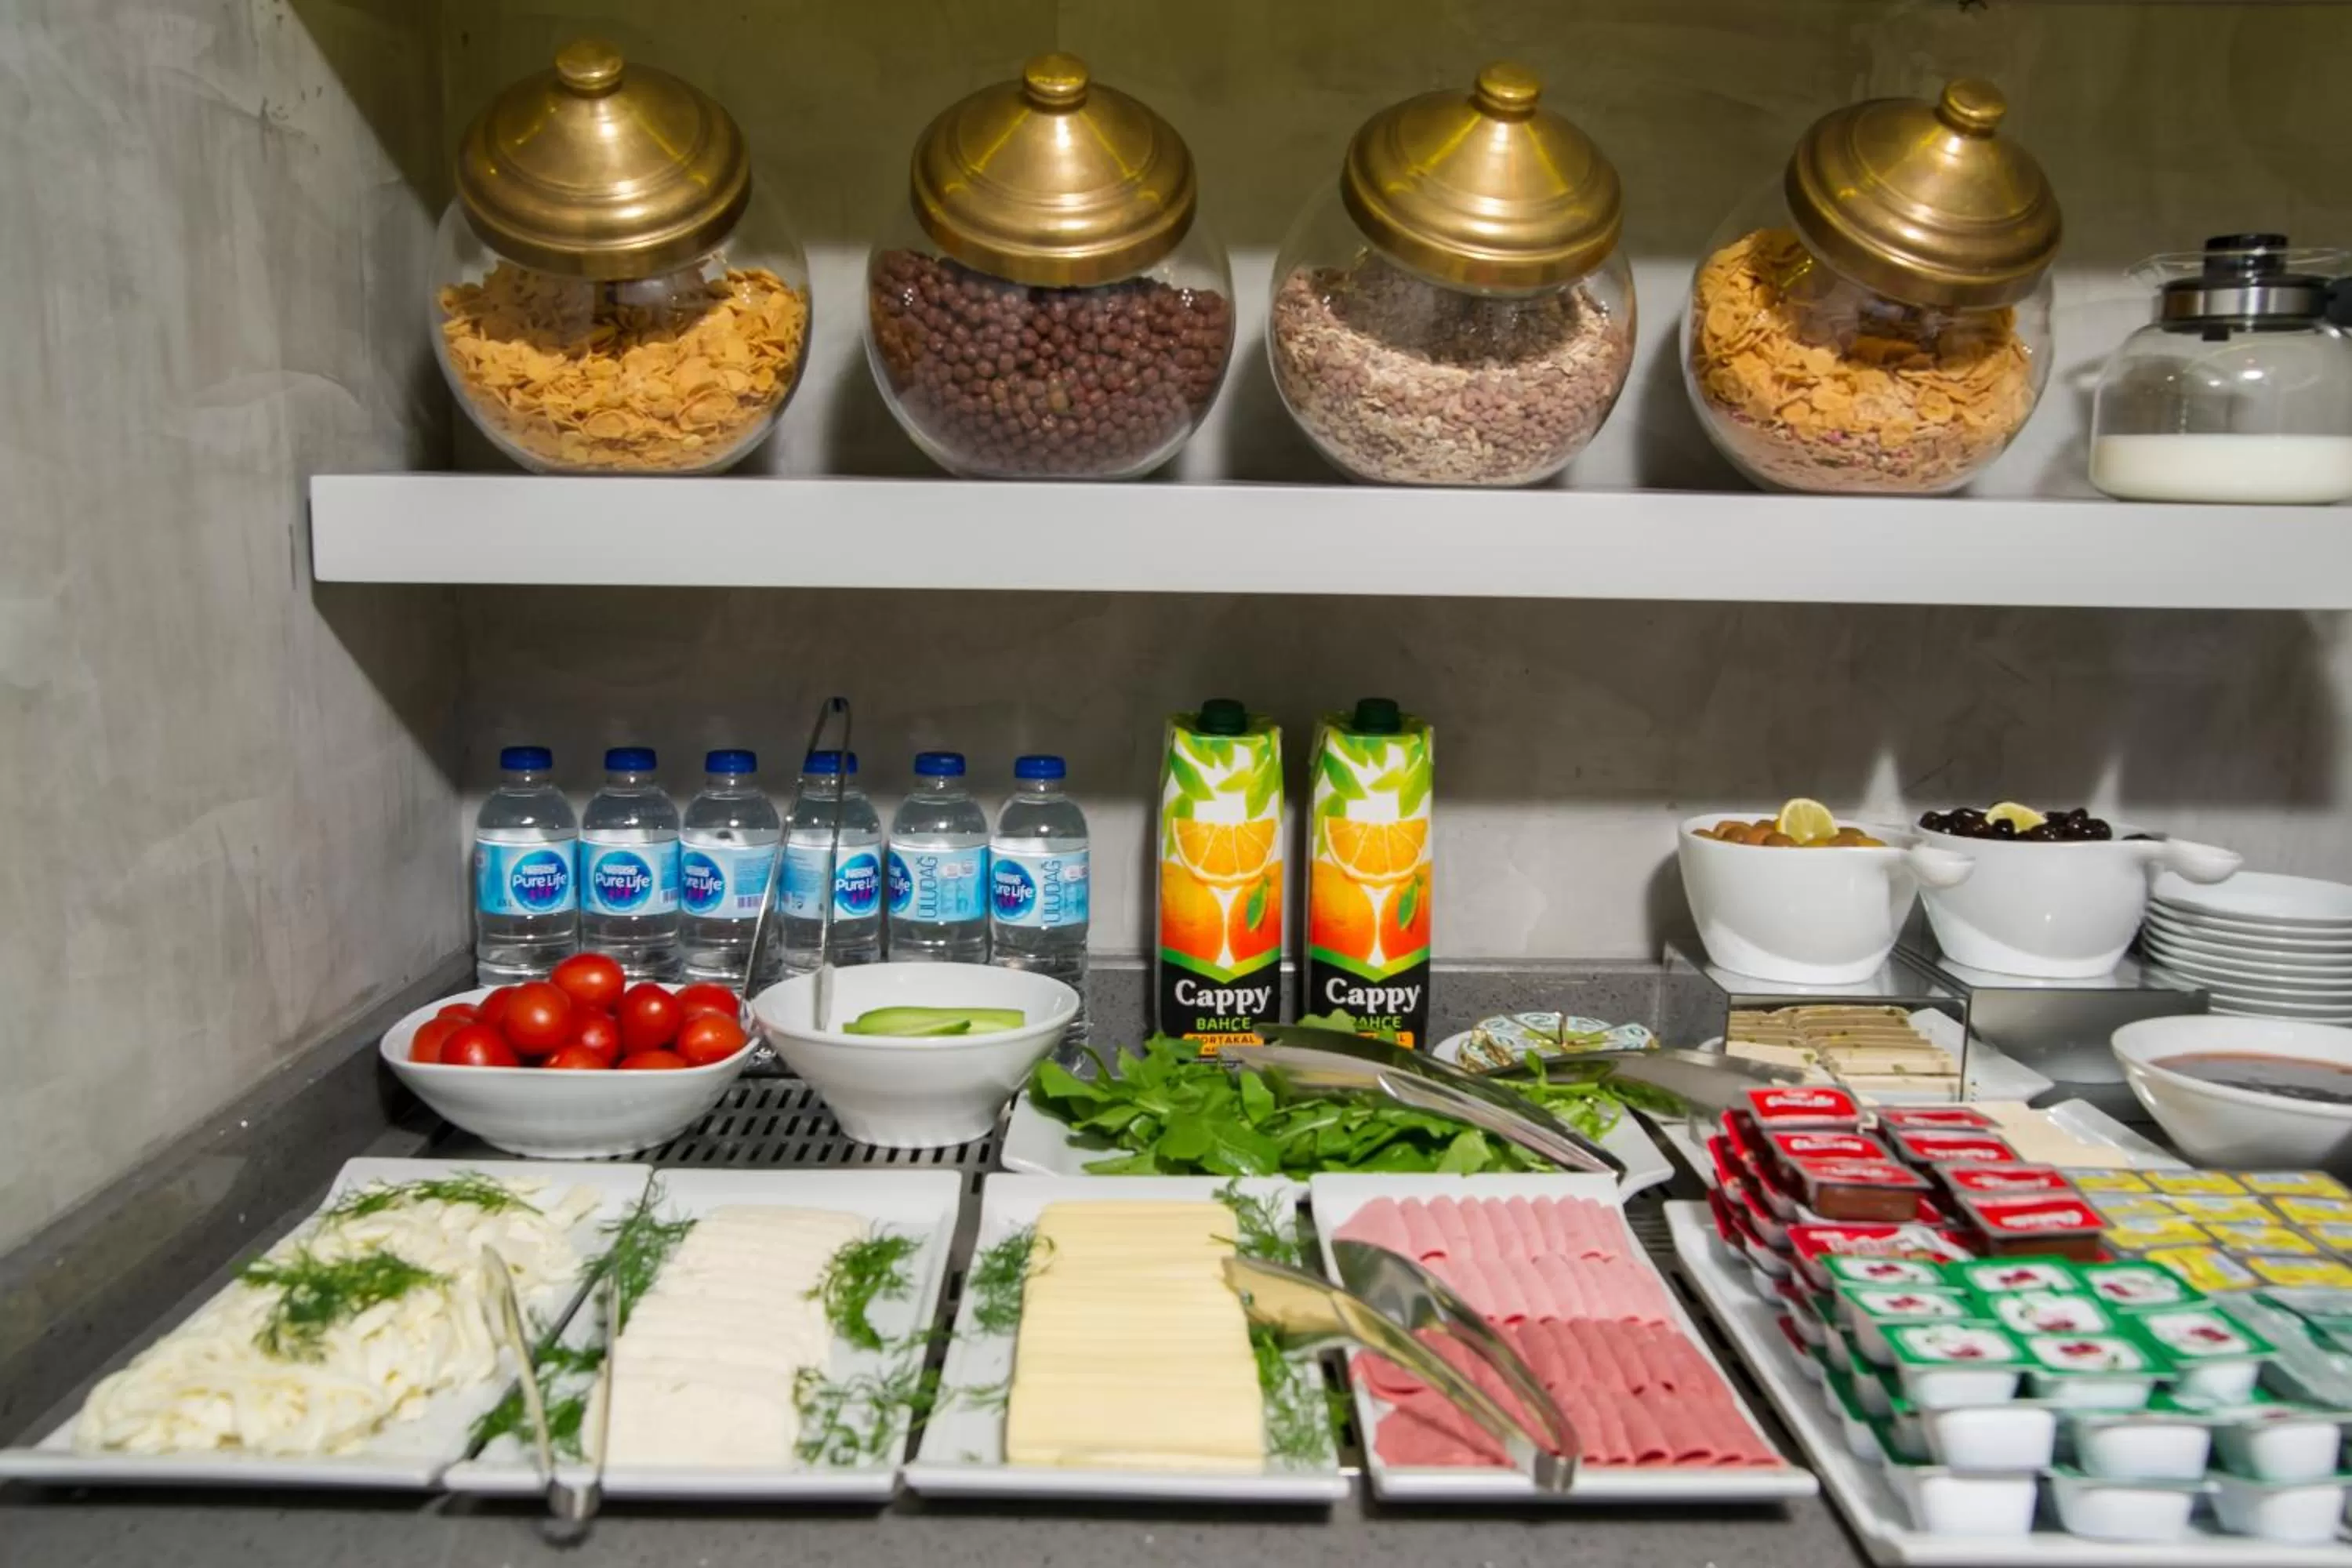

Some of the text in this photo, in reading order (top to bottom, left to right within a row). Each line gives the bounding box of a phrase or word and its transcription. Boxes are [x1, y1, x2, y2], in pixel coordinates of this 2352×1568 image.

[513, 872, 566, 891] Pure Life
[596, 872, 650, 892] Pure Life
[700, 877, 722, 895] Life
[836, 877, 866, 891] Pure
[994, 884, 1033, 902] ure Life
[1174, 978, 1272, 1015] Cappy
[1326, 977, 1421, 1014] Cappy
[1193, 1035, 1255, 1044] ORTAKAL
